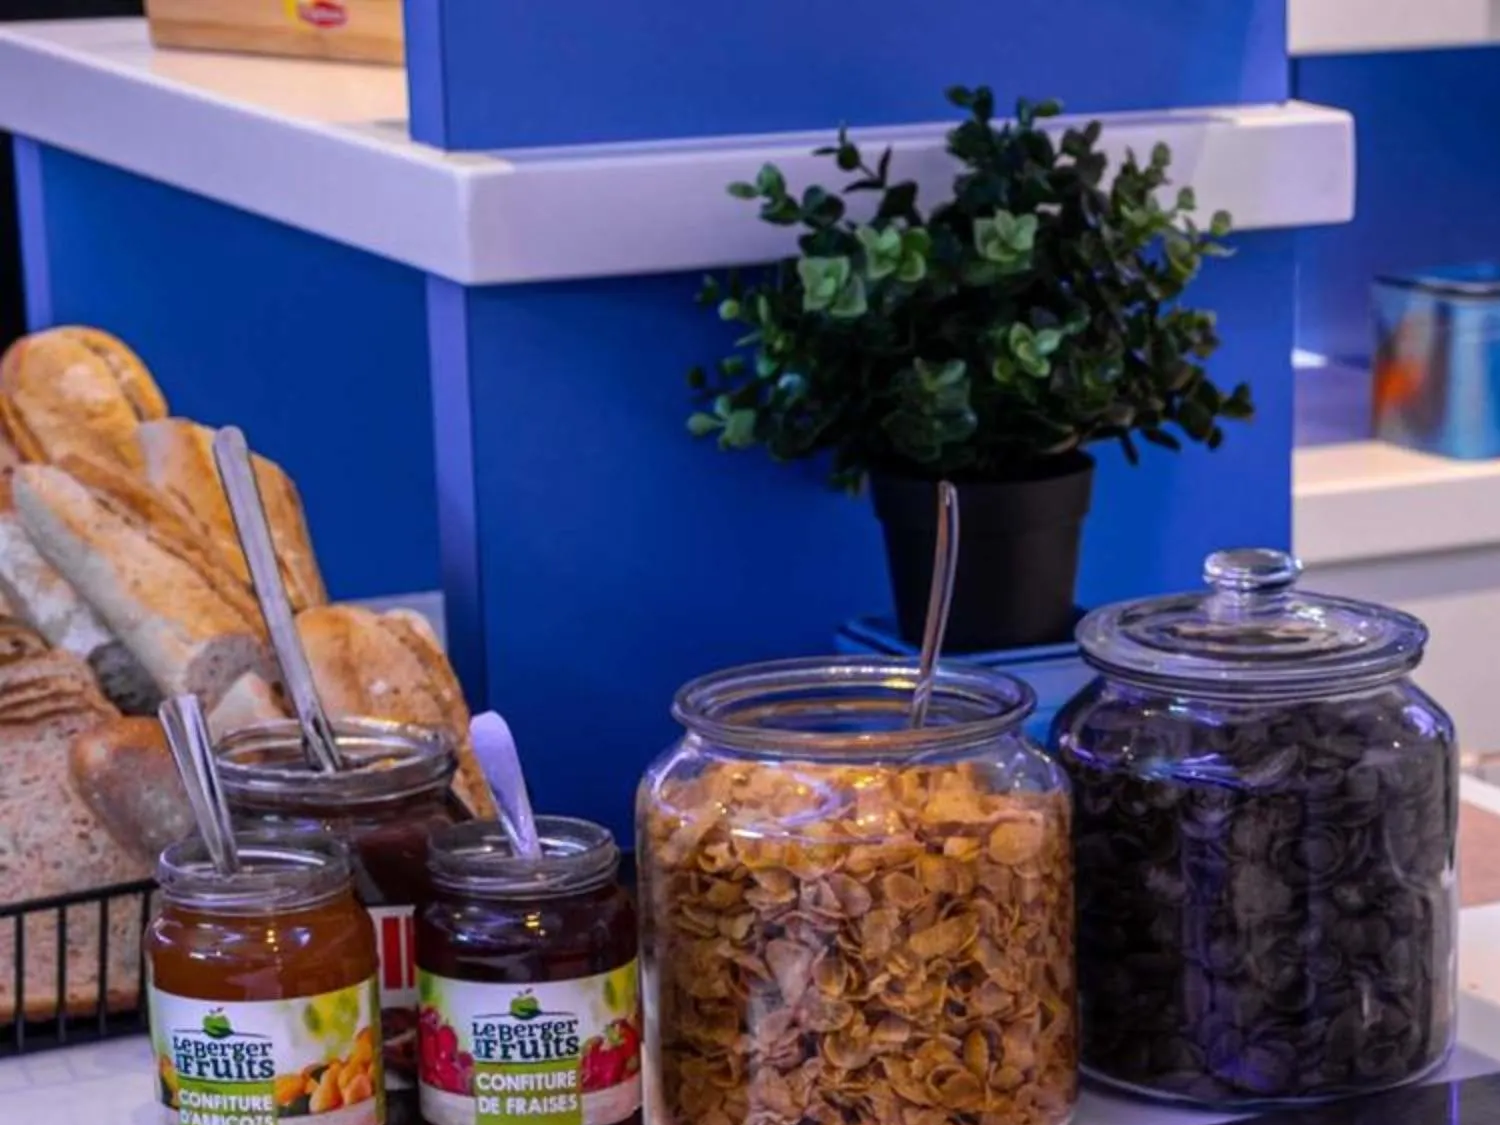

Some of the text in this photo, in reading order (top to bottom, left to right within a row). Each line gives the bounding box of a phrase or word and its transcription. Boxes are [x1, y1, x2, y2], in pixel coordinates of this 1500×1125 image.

[483, 1036, 579, 1059] Fruits
[183, 1054, 275, 1079] Fruits
[476, 1070, 577, 1091] CONFITURE
[179, 1089, 273, 1111] CONFITURE
[479, 1094, 578, 1115] DE FRAISES
